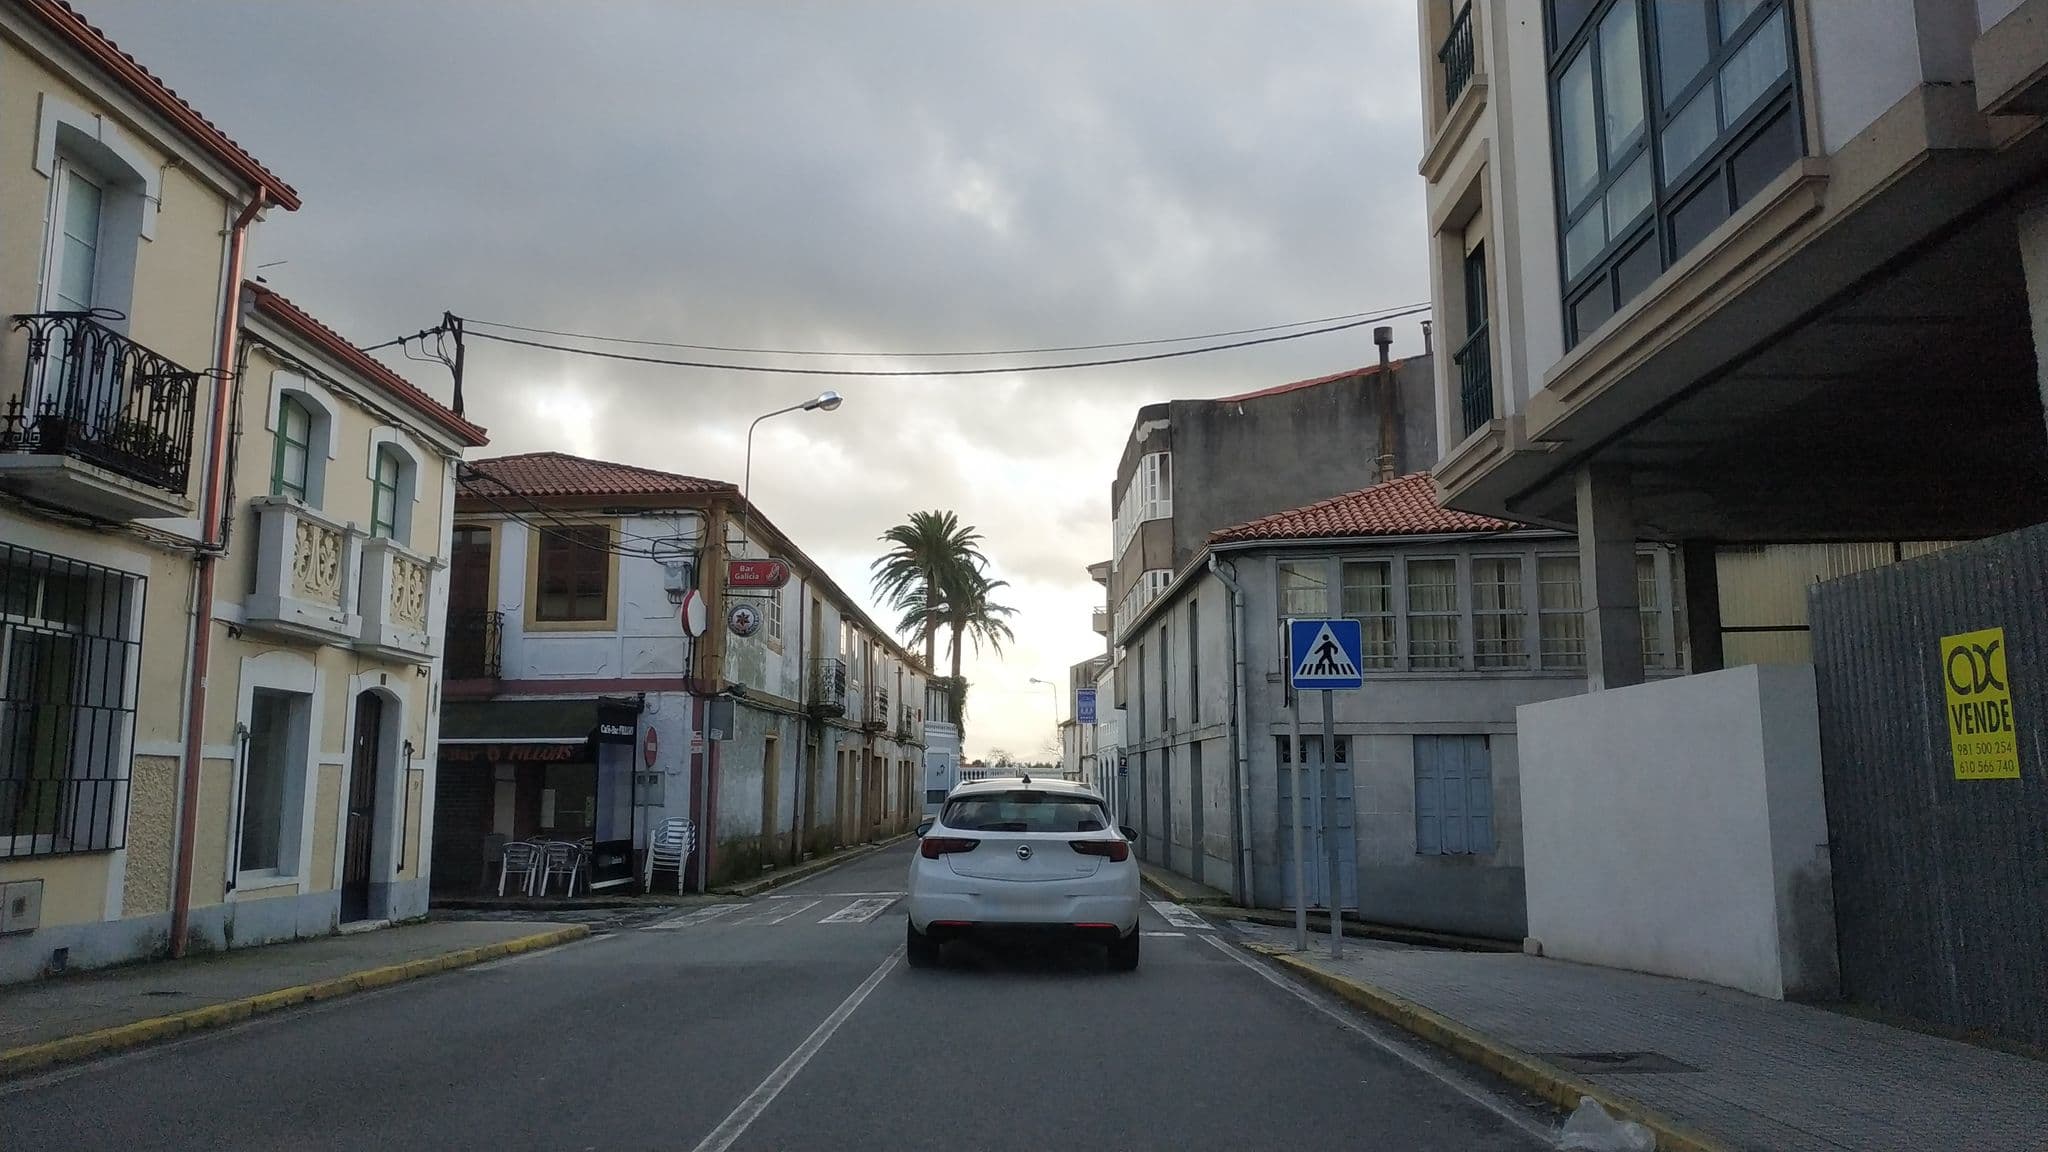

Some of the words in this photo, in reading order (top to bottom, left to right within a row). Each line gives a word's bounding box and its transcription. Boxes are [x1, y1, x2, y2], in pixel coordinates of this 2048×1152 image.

[734, 572, 760, 580] Galicia
[1951, 699, 2012, 735] VENDE
[1957, 743, 1972, 756] 981
[1975, 742, 1993, 755] 500
[1994, 741, 2012, 754] 254
[1959, 760, 1976, 773] 610
[1977, 760, 1994, 773] 566
[1996, 759, 2015, 772] 740
